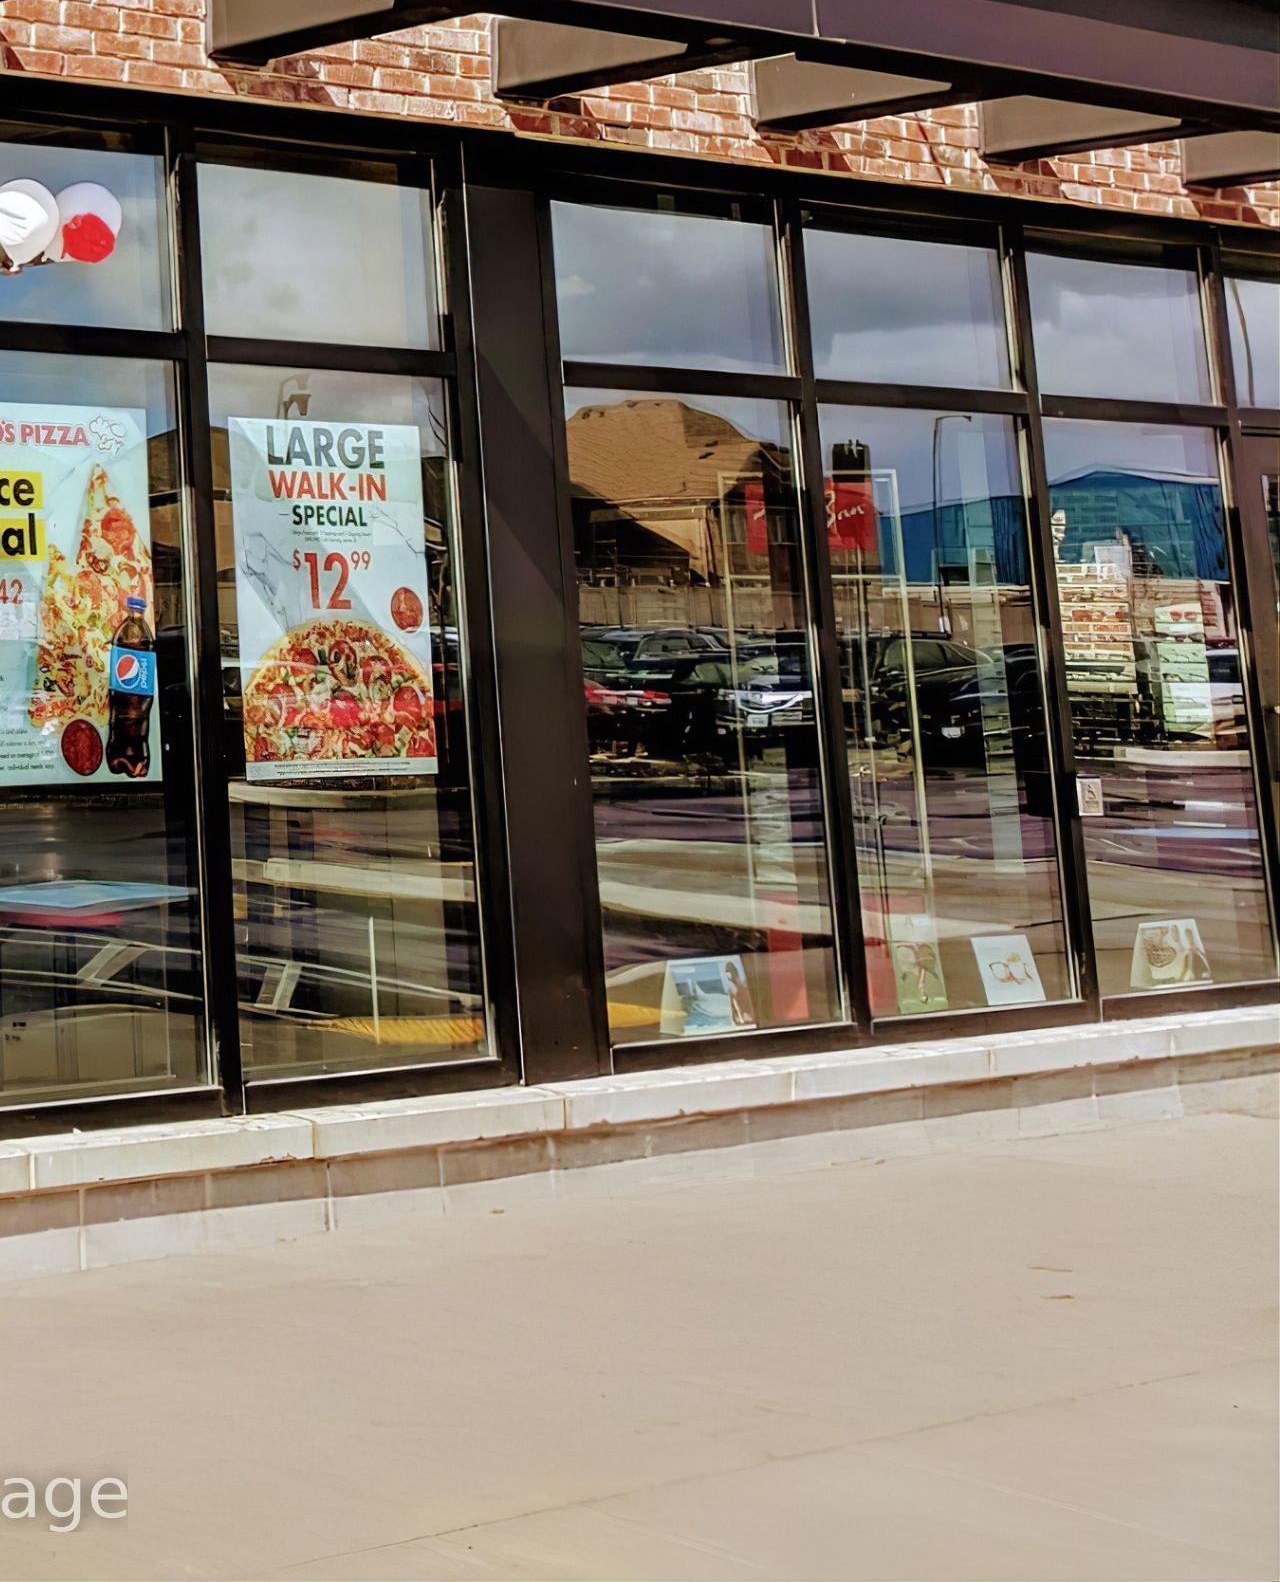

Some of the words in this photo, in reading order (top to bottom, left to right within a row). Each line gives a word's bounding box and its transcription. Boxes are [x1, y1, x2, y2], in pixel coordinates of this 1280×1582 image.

[20, 424, 89, 445] PIZZA
[266, 425, 385, 469] LARGE
[268, 470, 386, 501] WALK-IN
[292, 505, 367, 526] SPECIAL
